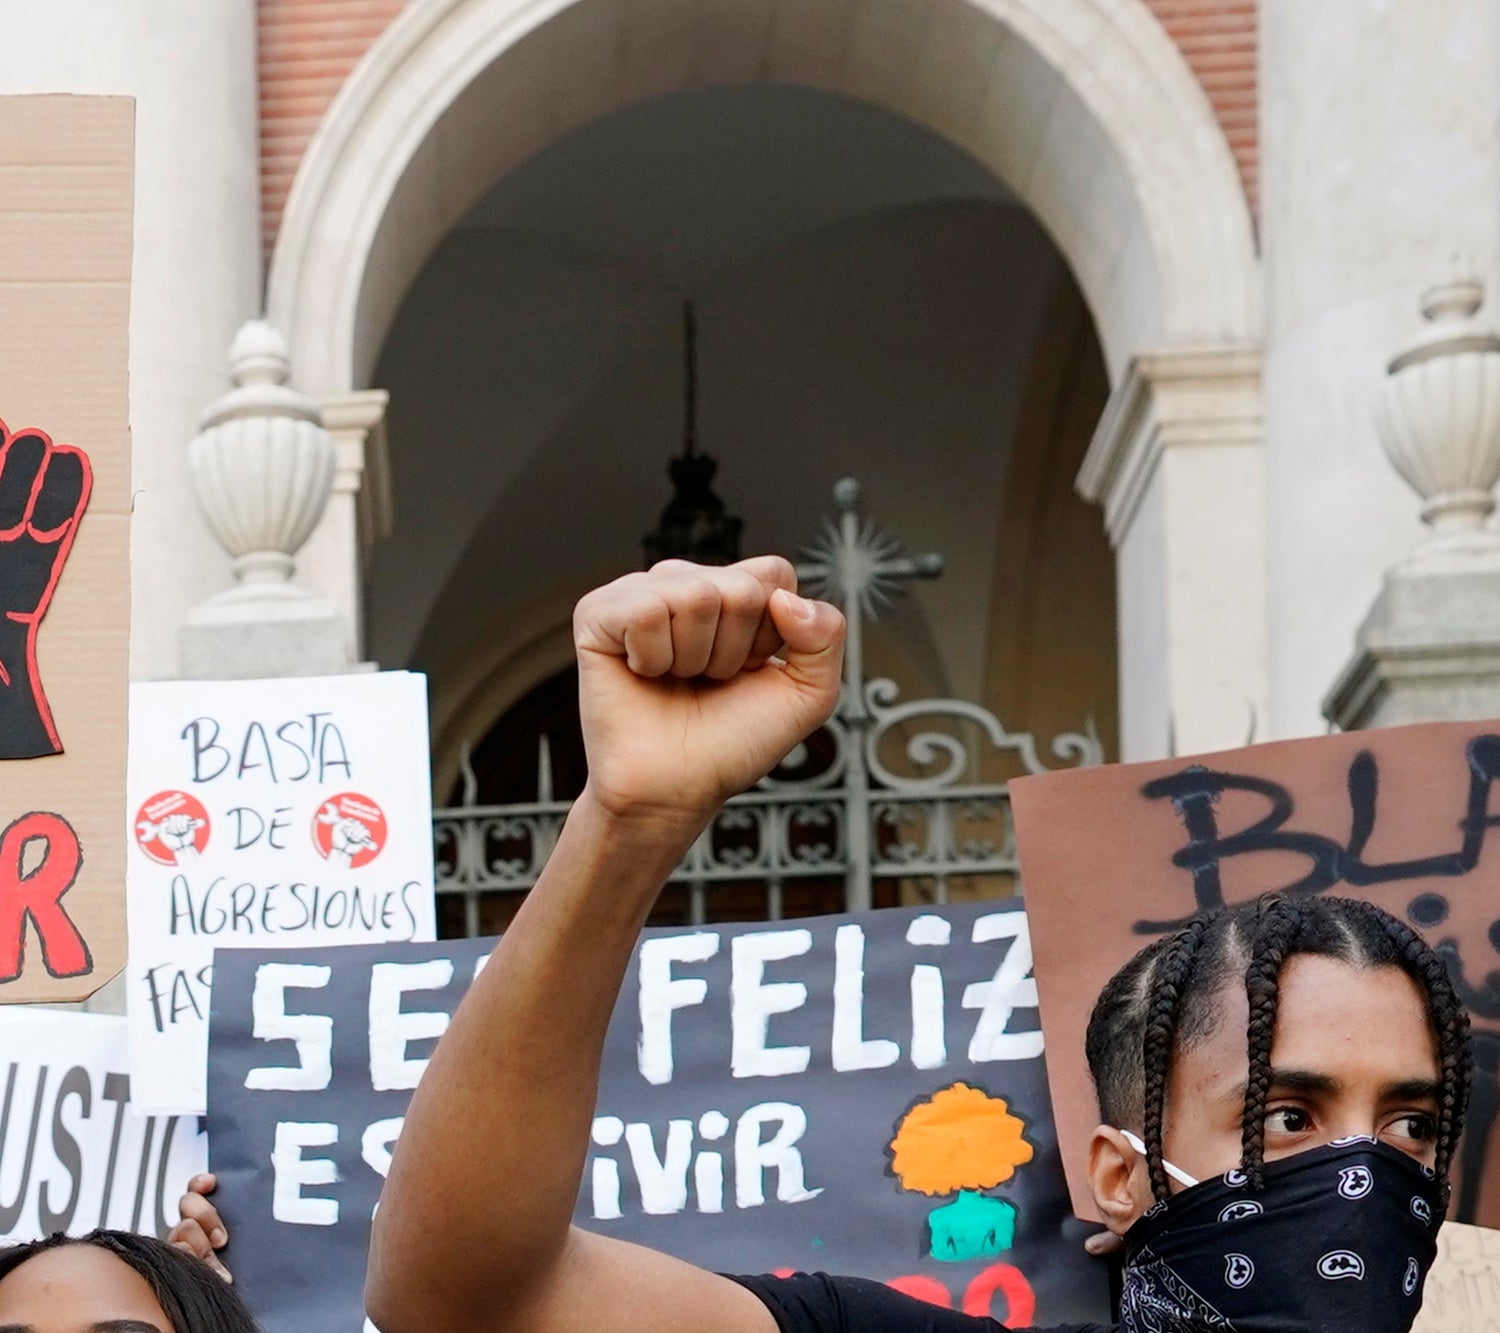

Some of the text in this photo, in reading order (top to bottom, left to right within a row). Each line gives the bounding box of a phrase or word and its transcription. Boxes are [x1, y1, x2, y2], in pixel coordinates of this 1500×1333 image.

[180, 712, 352, 784] BASTA
[226, 806, 294, 850] DE
[169, 873, 422, 942] AGRESIONES
[142, 961, 213, 1033] FA
[244, 950, 490, 1092] SE
